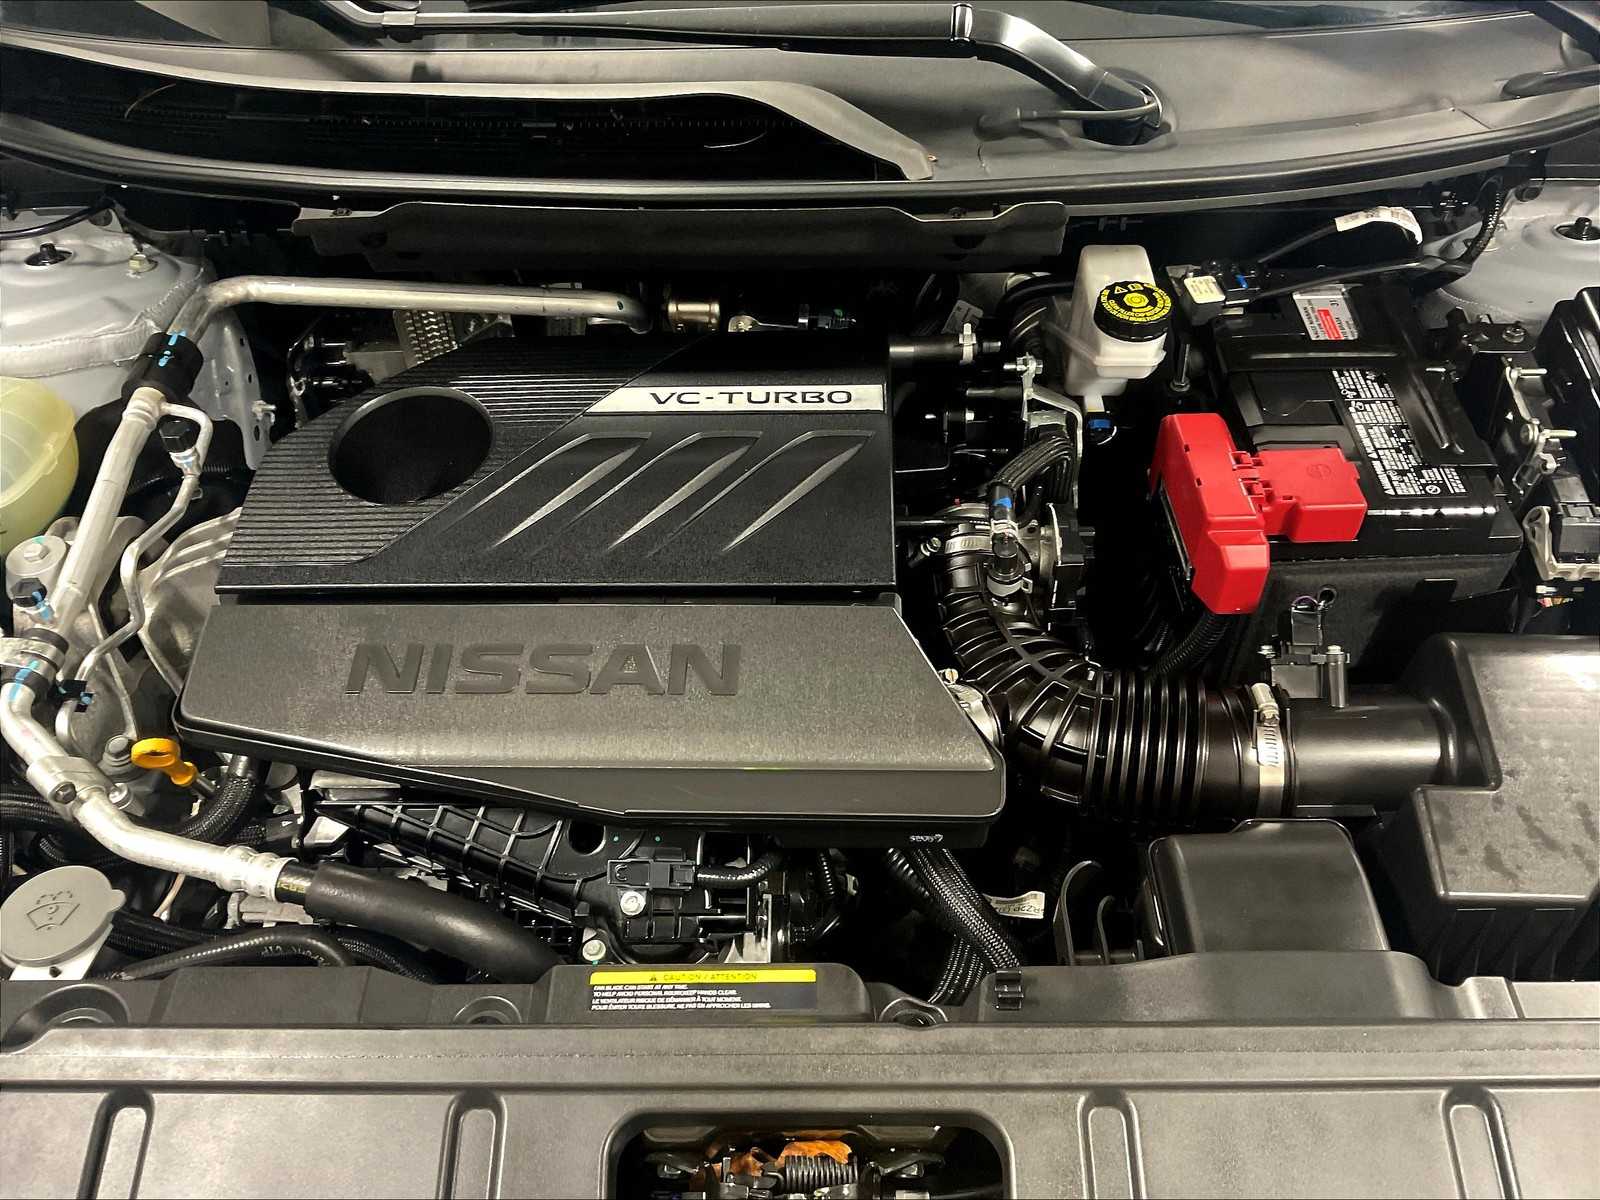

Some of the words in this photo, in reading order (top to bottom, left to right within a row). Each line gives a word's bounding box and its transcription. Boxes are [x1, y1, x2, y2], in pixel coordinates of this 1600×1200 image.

[650, 391, 852, 405] VC-TURBO
[345, 643, 742, 696] NISSAN
[664, 973, 700, 981] CAUTION
[710, 972, 758, 980] ATTENTION
